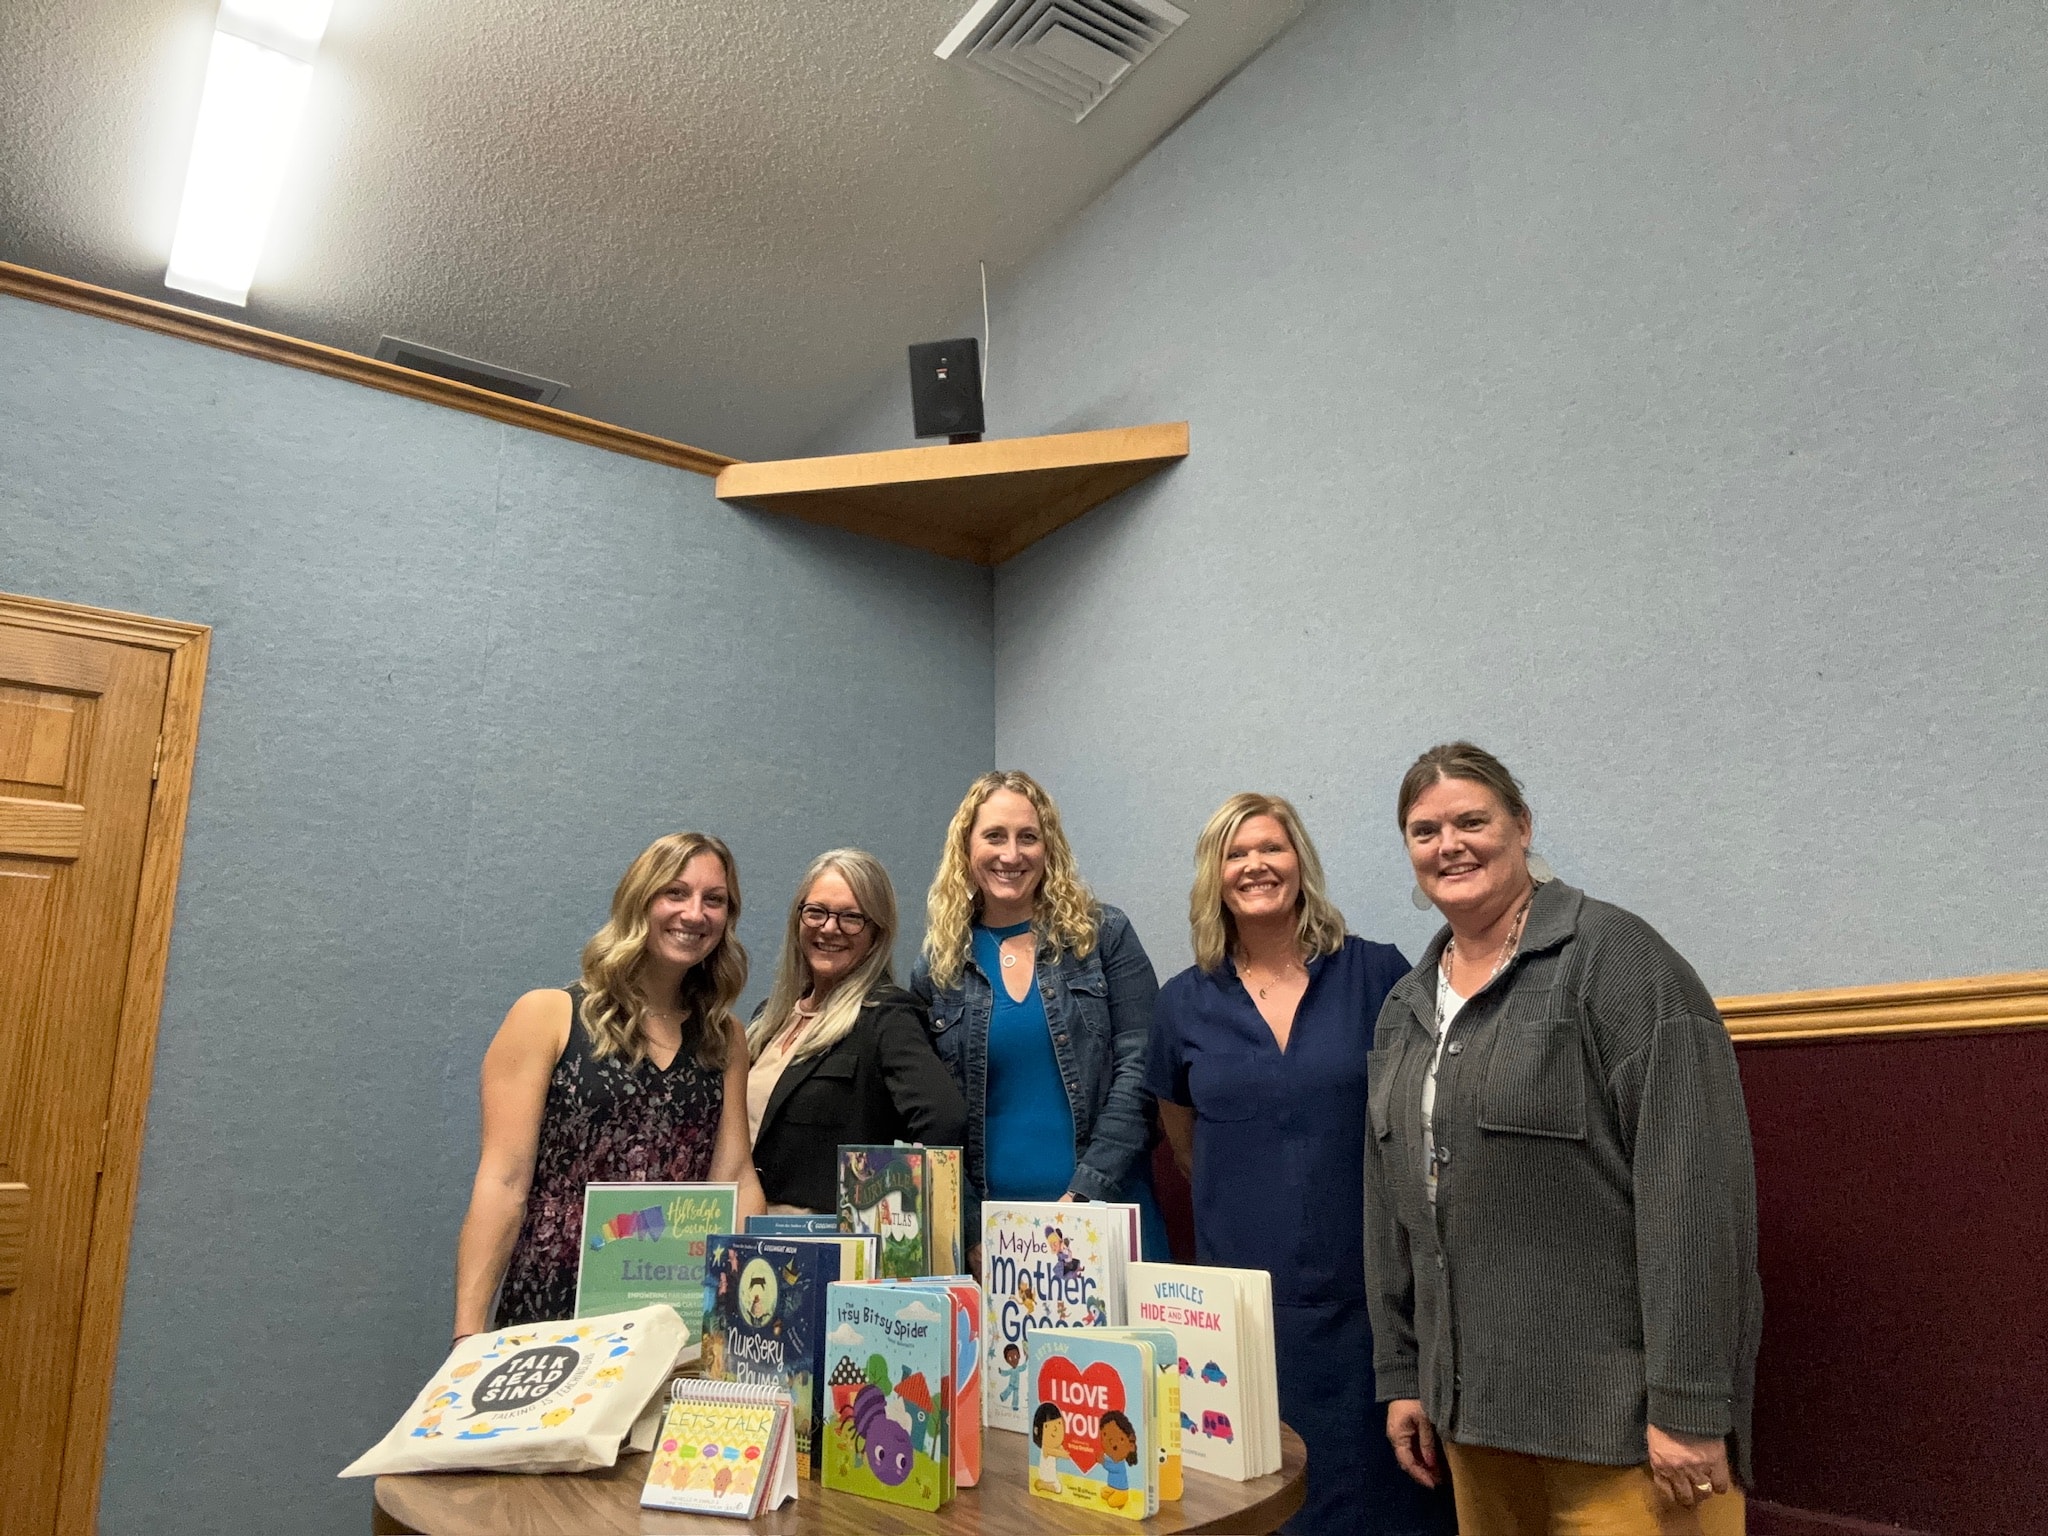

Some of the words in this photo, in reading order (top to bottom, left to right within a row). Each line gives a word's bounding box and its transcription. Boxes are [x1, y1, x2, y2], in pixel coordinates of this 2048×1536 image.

[880, 1199, 912, 1227] ATLAS
[673, 1219, 722, 1239] County
[1000, 1229, 1048, 1262] Maybe
[621, 1259, 706, 1280] Literac
[1154, 1282, 1204, 1305] VEHICLES
[838, 1307, 860, 1325] Itsy
[863, 1307, 893, 1335] Bitsy
[894, 1320, 928, 1341] Spider
[1140, 1302, 1166, 1322] HIDE
[1167, 1311, 1182, 1321] AND
[1184, 1309, 1221, 1332] SNEAK
[507, 1354, 569, 1373] TALK
[488, 1370, 563, 1388] READ
[481, 1384, 549, 1402] SING
[1051, 1379, 1057, 1401] I
[1061, 1380, 1108, 1410] LOVE
[491, 1405, 536, 1420] TALKING
[541, 1399, 554, 1407] IS
[724, 1415, 771, 1433] TALK
[1061, 1410, 1100, 1440] YOU
